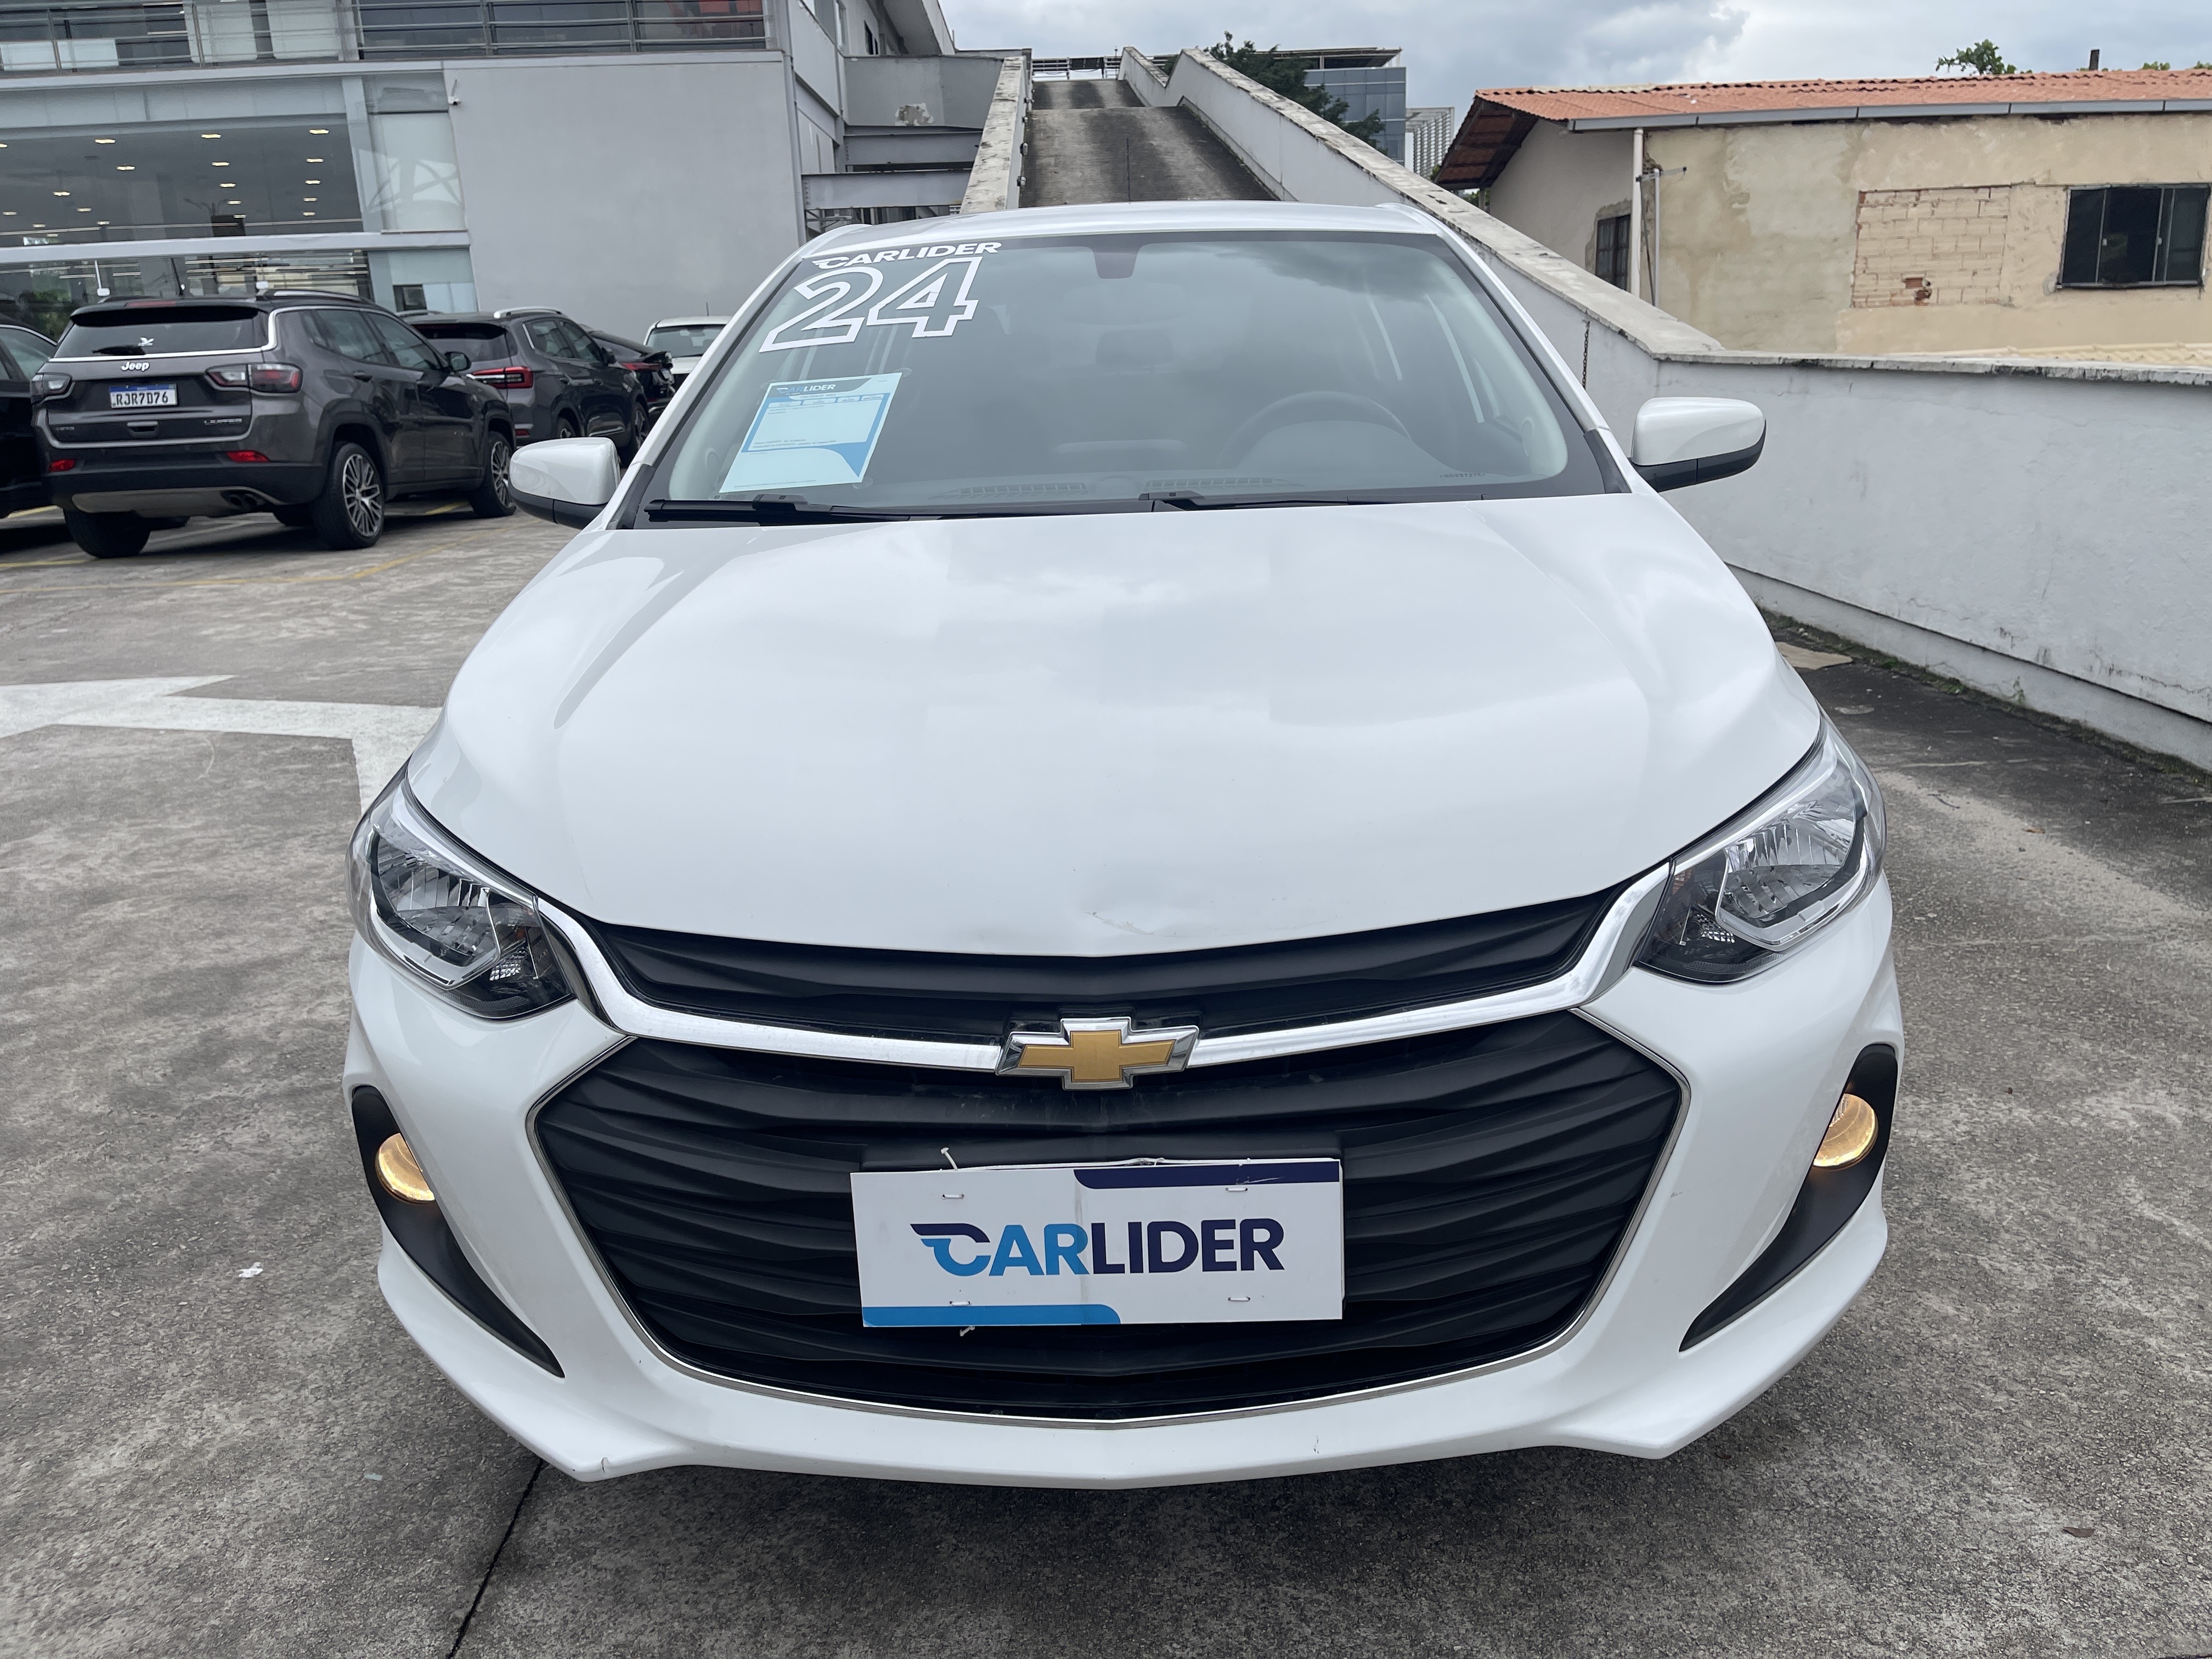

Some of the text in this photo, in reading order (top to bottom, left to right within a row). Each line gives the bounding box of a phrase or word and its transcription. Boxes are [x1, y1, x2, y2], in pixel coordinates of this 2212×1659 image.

[812, 242, 1002, 269] CARLIDER
[759, 256, 983, 353] 24
[121, 360, 150, 372] Jeep
[776, 384, 836, 393] CARLIDER
[116, 392, 168, 406] RJR7D76
[910, 1218, 1285, 1277] CARLIDER
